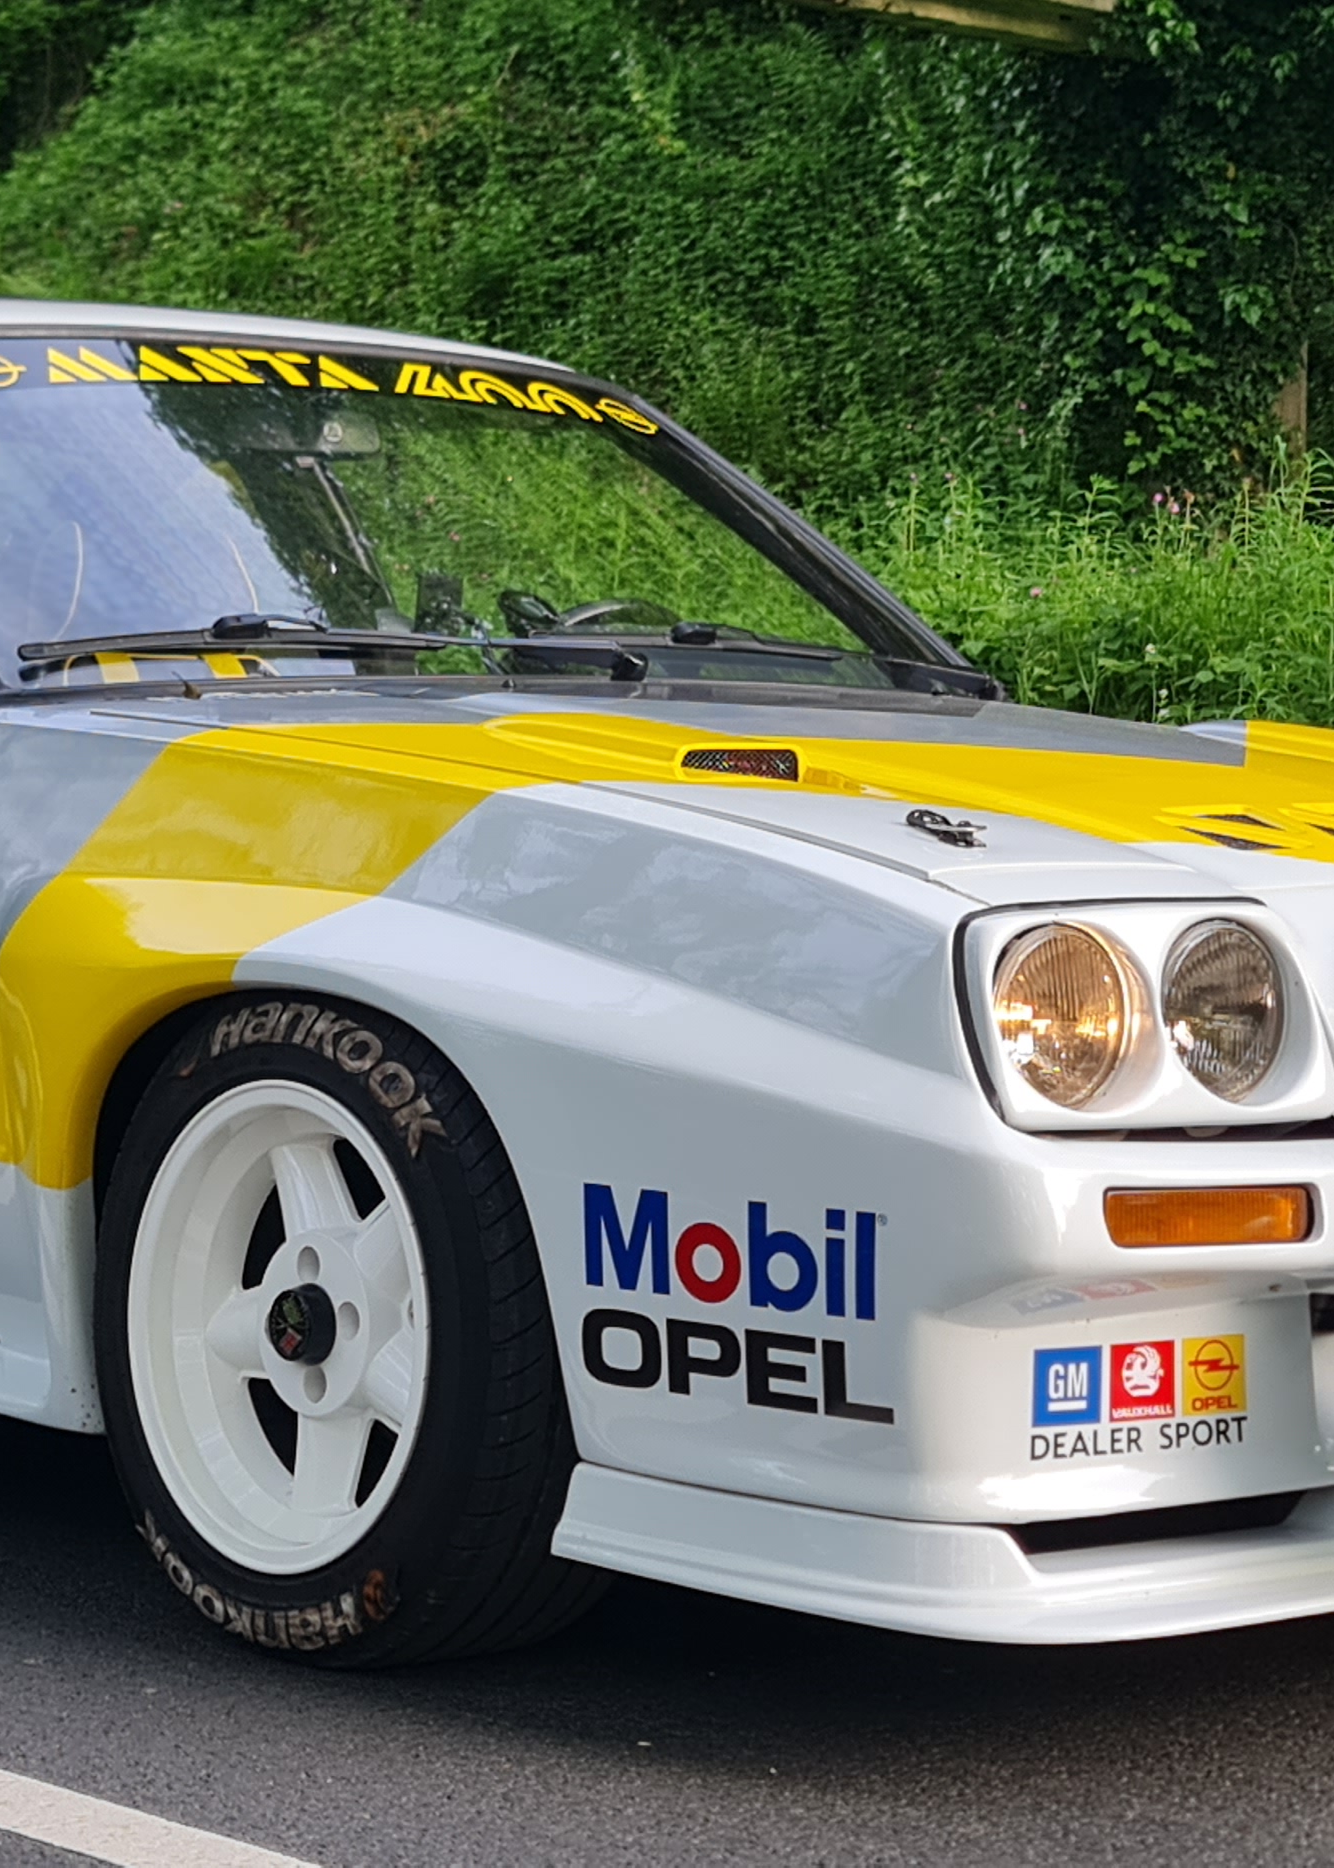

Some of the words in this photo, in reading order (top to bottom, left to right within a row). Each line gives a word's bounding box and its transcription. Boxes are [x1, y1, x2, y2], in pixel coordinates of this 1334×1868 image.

[47, 345, 379, 392] MANTA
[395, 362, 604, 422] 400
[582, 1182, 877, 1321] Mobil
[581, 1308, 895, 1425] OPEL
[1048, 1362, 1088, 1400] GM
[1112, 1403, 1174, 1419] VAUXHALL
[1191, 1395, 1238, 1412] OPEL
[1030, 1426, 1144, 1461] DEALER
[1159, 1416, 1248, 1451] SPORT
